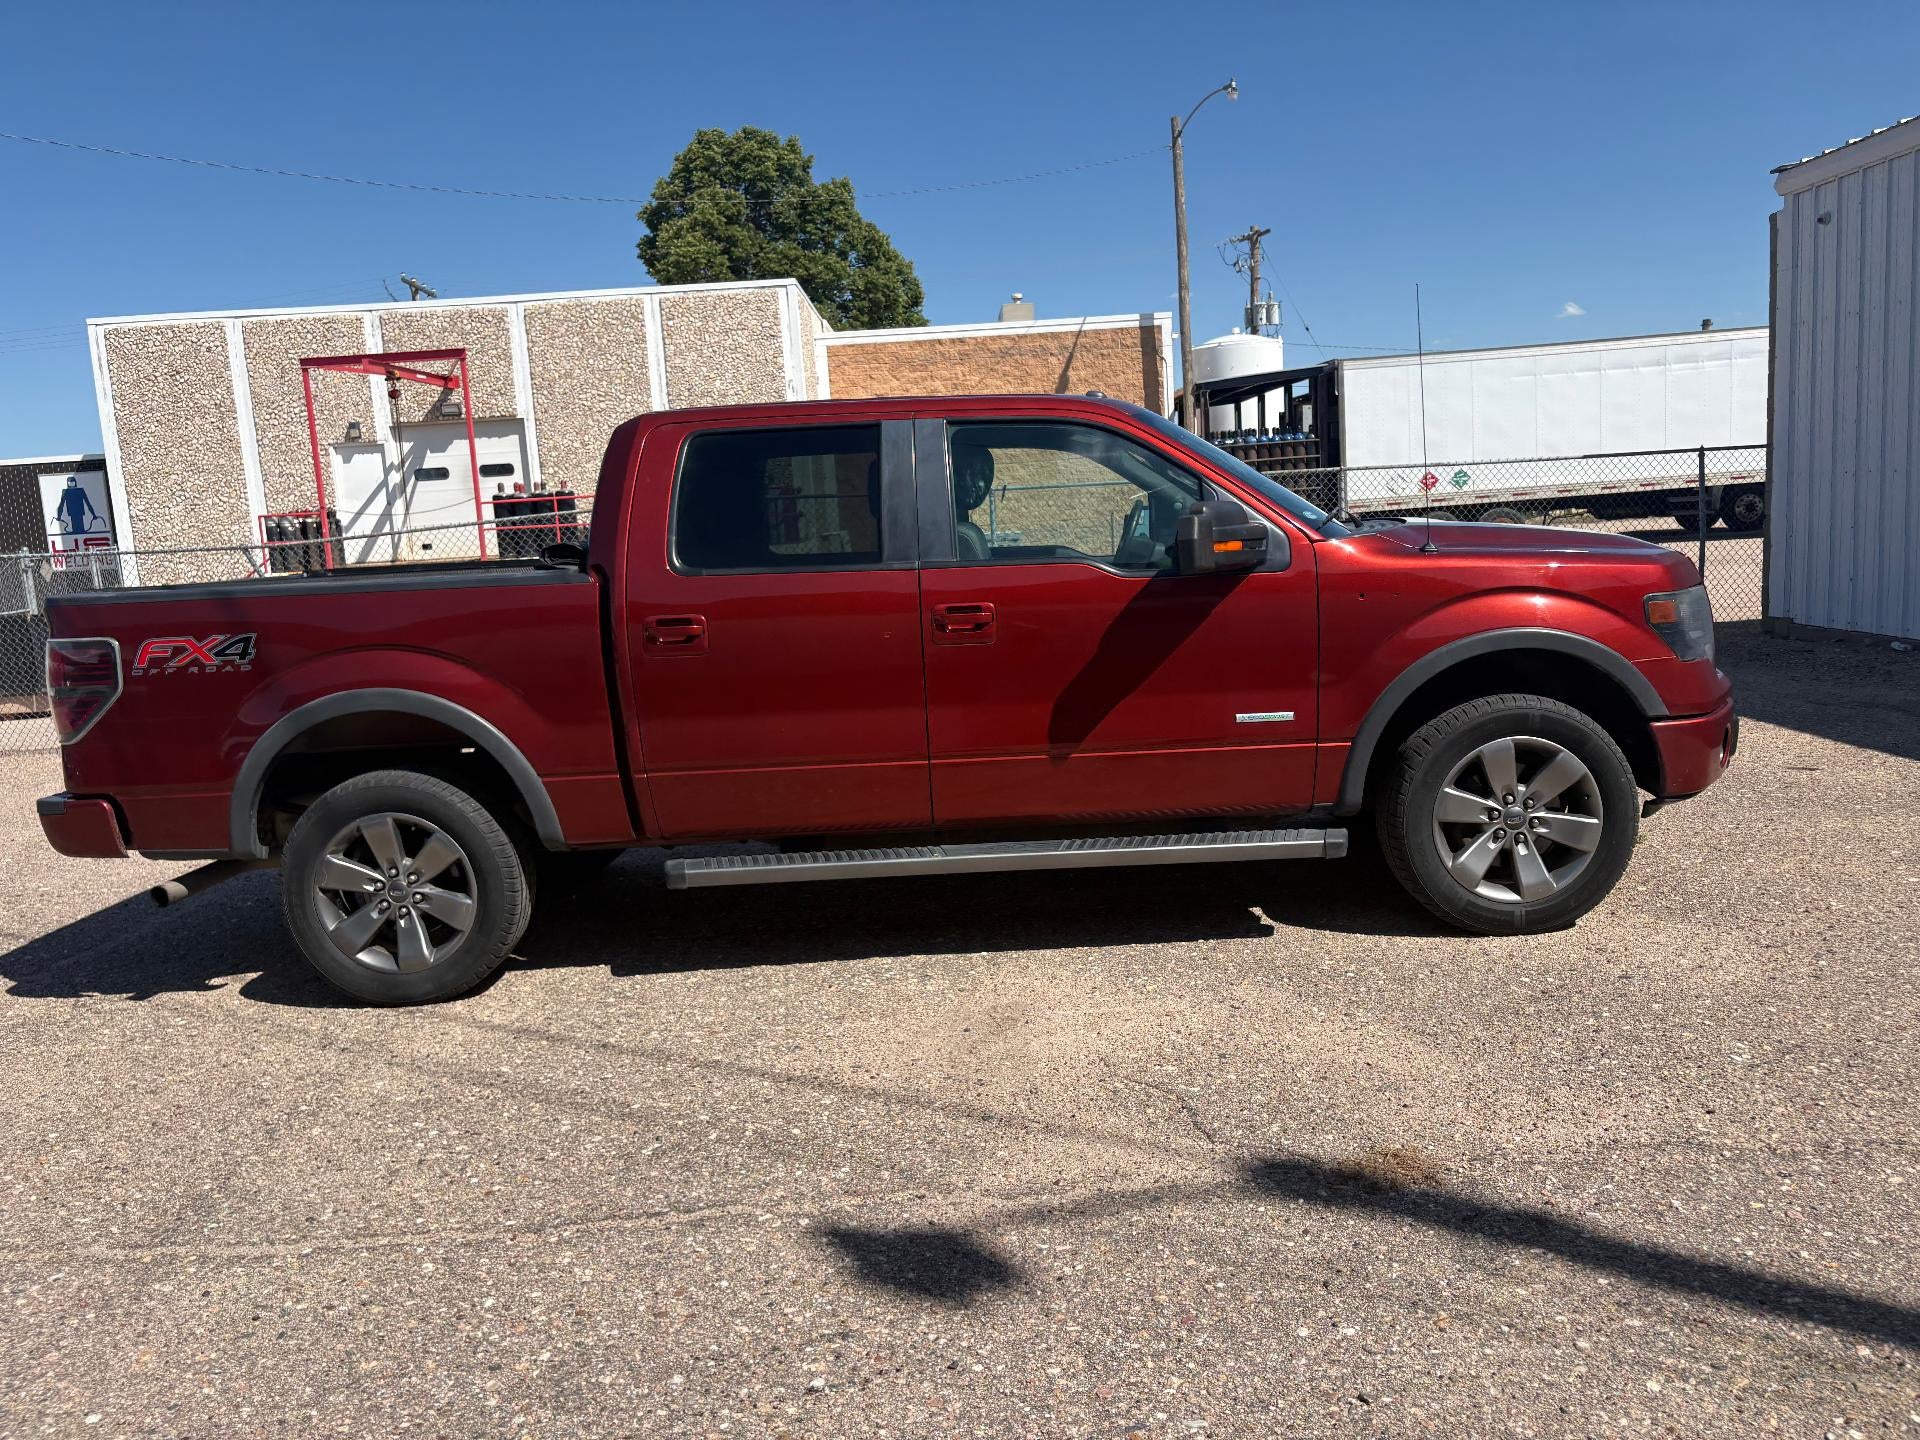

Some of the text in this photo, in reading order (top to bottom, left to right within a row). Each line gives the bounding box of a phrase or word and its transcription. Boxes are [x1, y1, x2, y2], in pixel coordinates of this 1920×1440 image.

[134, 633, 257, 667] FX4
[132, 664, 252, 676] OFF ROAD
